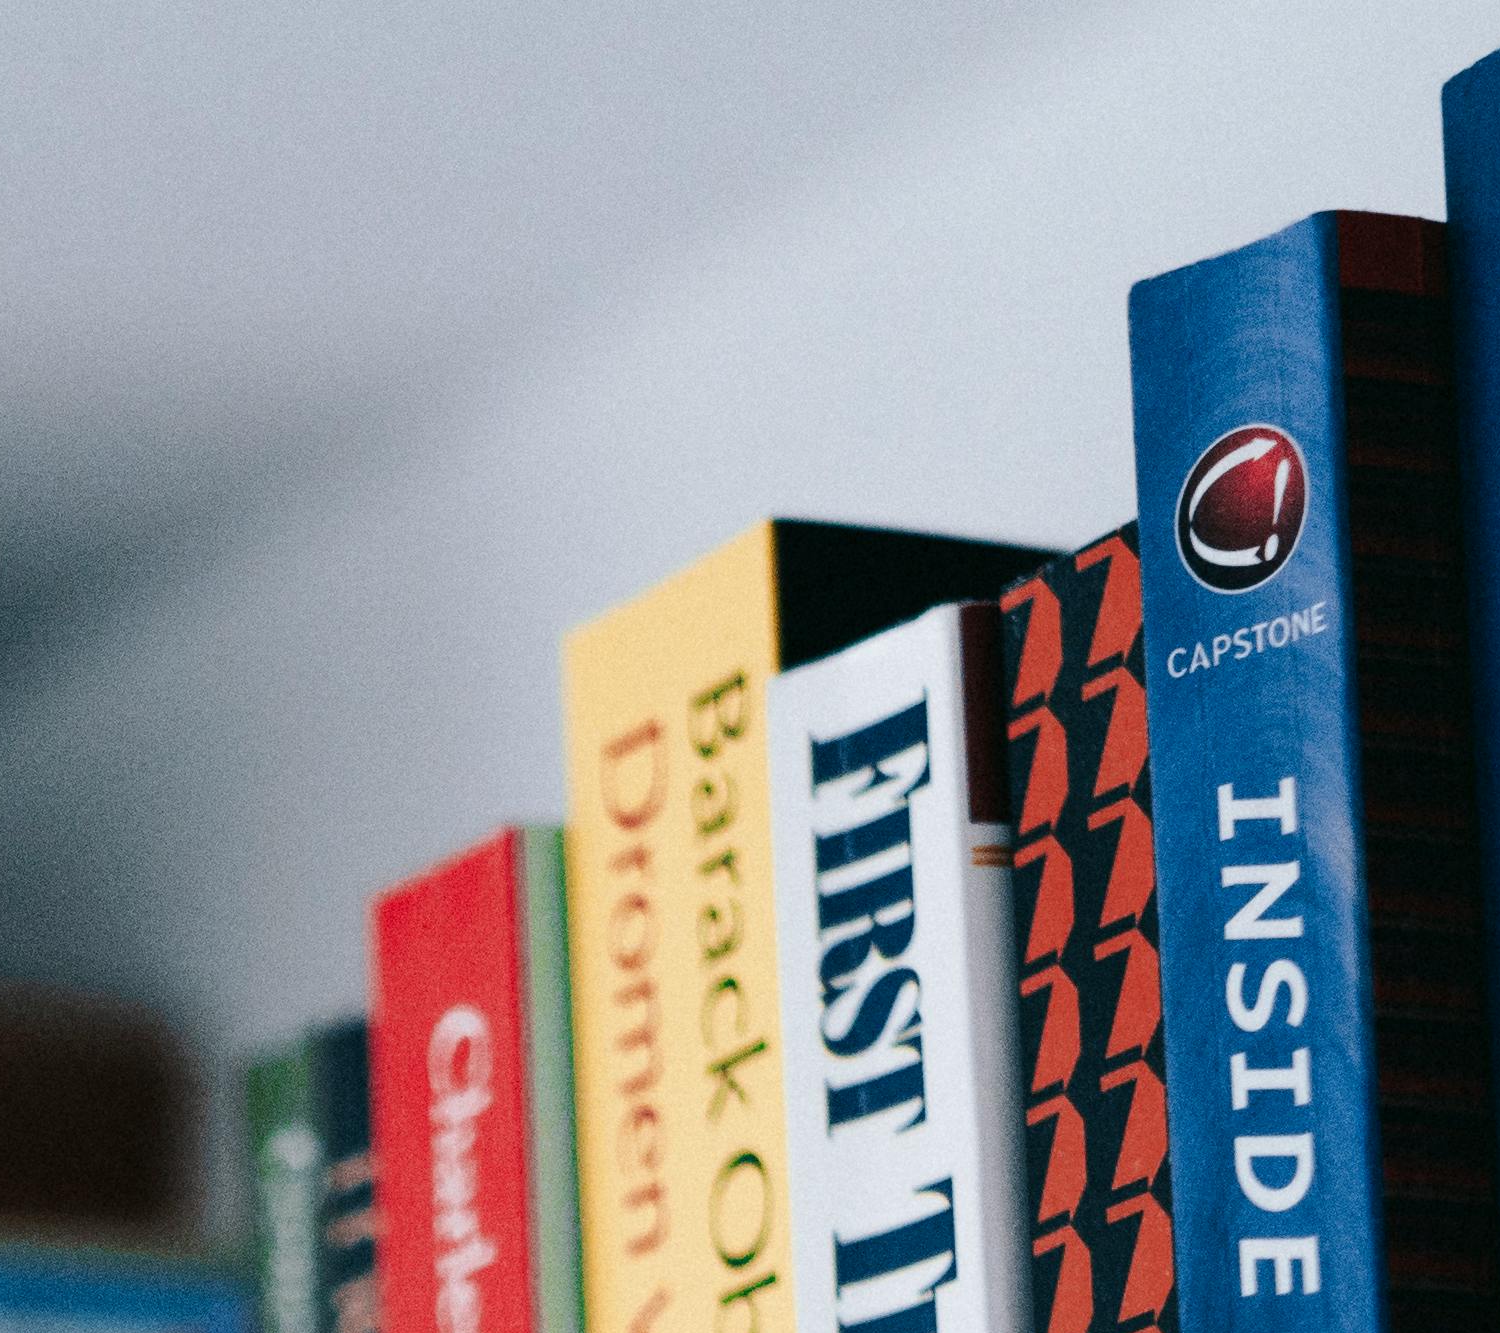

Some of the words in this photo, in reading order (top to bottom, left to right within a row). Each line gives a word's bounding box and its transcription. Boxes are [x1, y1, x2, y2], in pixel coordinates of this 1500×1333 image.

[1167, 602, 1329, 678] CAPSTONE
[601, 716, 672, 1262] Dromen
[687, 666, 771, 1126] Barack
[811, 686, 932, 1139] FIRST
[1217, 776, 1322, 1298] INSIDE
